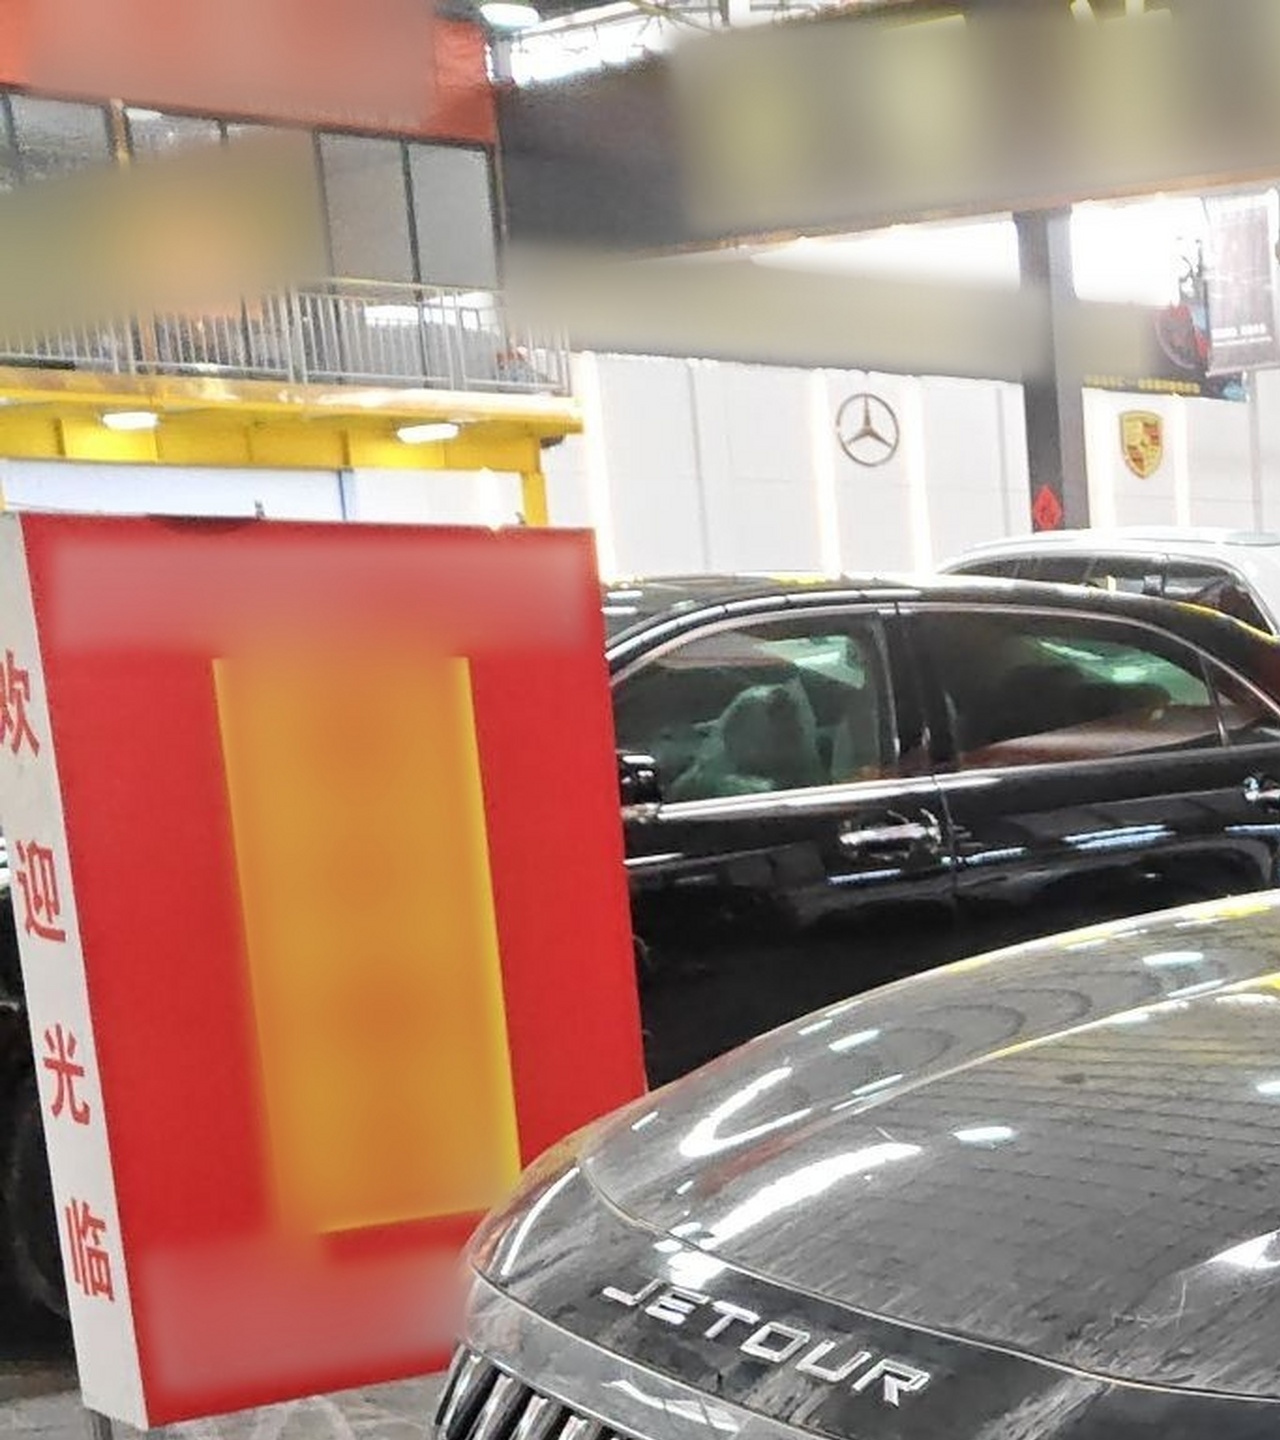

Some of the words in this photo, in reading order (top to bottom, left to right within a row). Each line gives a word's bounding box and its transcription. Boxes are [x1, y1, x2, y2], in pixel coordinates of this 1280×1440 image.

[0, 648, 117, 1304] 欢迎光临
[602, 1278, 931, 1408] JETOUR
